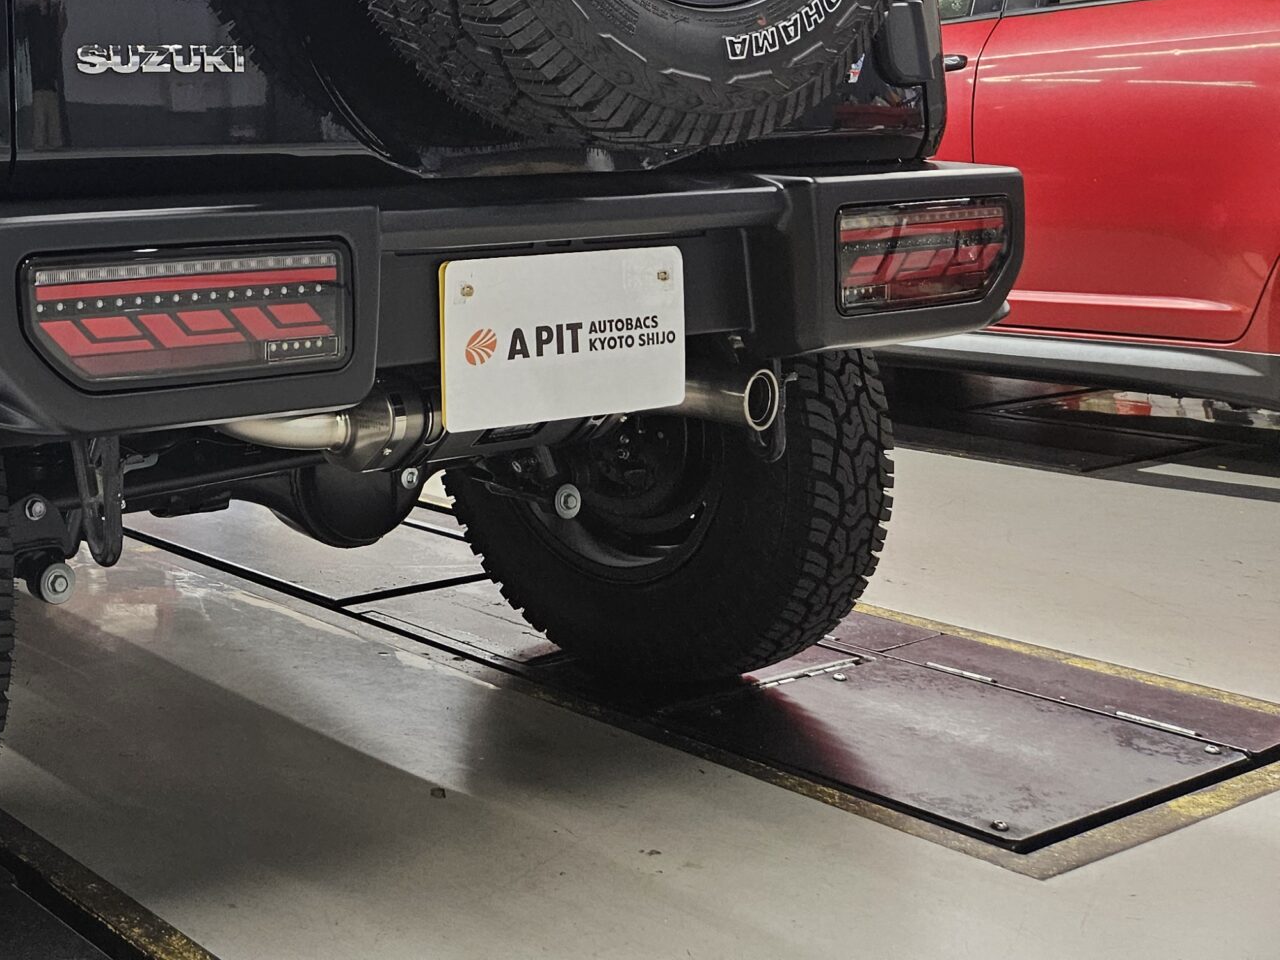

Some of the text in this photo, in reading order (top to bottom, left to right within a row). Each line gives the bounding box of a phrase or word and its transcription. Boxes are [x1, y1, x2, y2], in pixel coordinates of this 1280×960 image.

[76, 44, 245, 74] SUZUKI
[588, 315, 659, 335] AUTOBACS
[588, 330, 676, 352] KYOTO SHIJO
